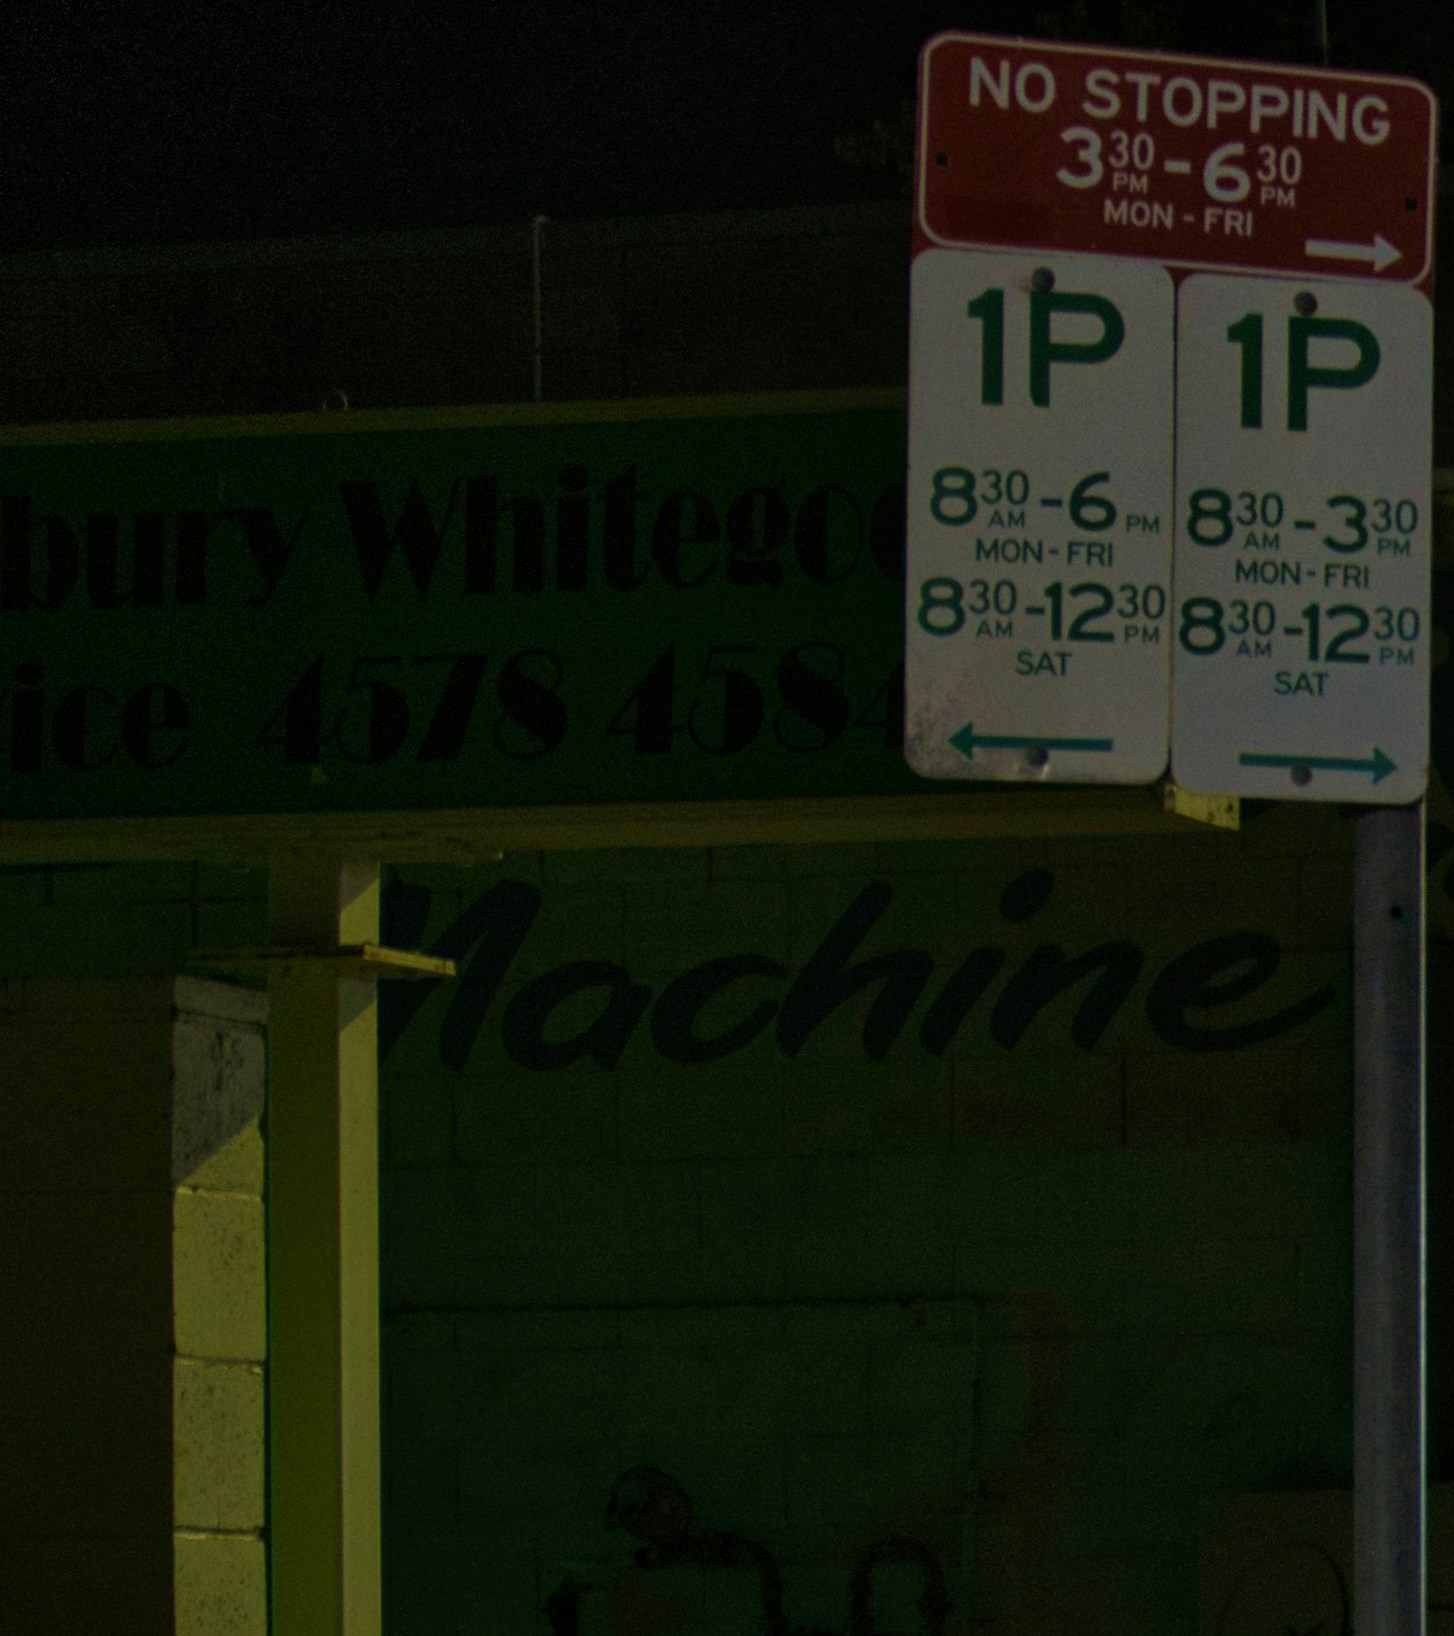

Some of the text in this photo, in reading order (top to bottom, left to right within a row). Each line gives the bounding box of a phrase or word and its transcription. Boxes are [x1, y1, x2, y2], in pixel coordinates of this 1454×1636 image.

[970, 57, 1391, 146] NO STOPPING
[968, 287, 1125, 408] 1P
[1228, 313, 1381, 433] 1P
[256, 647, 570, 766] 4578
[1015, 650, 1072, 677] SAT
[1274, 671, 1330, 697] SAT
